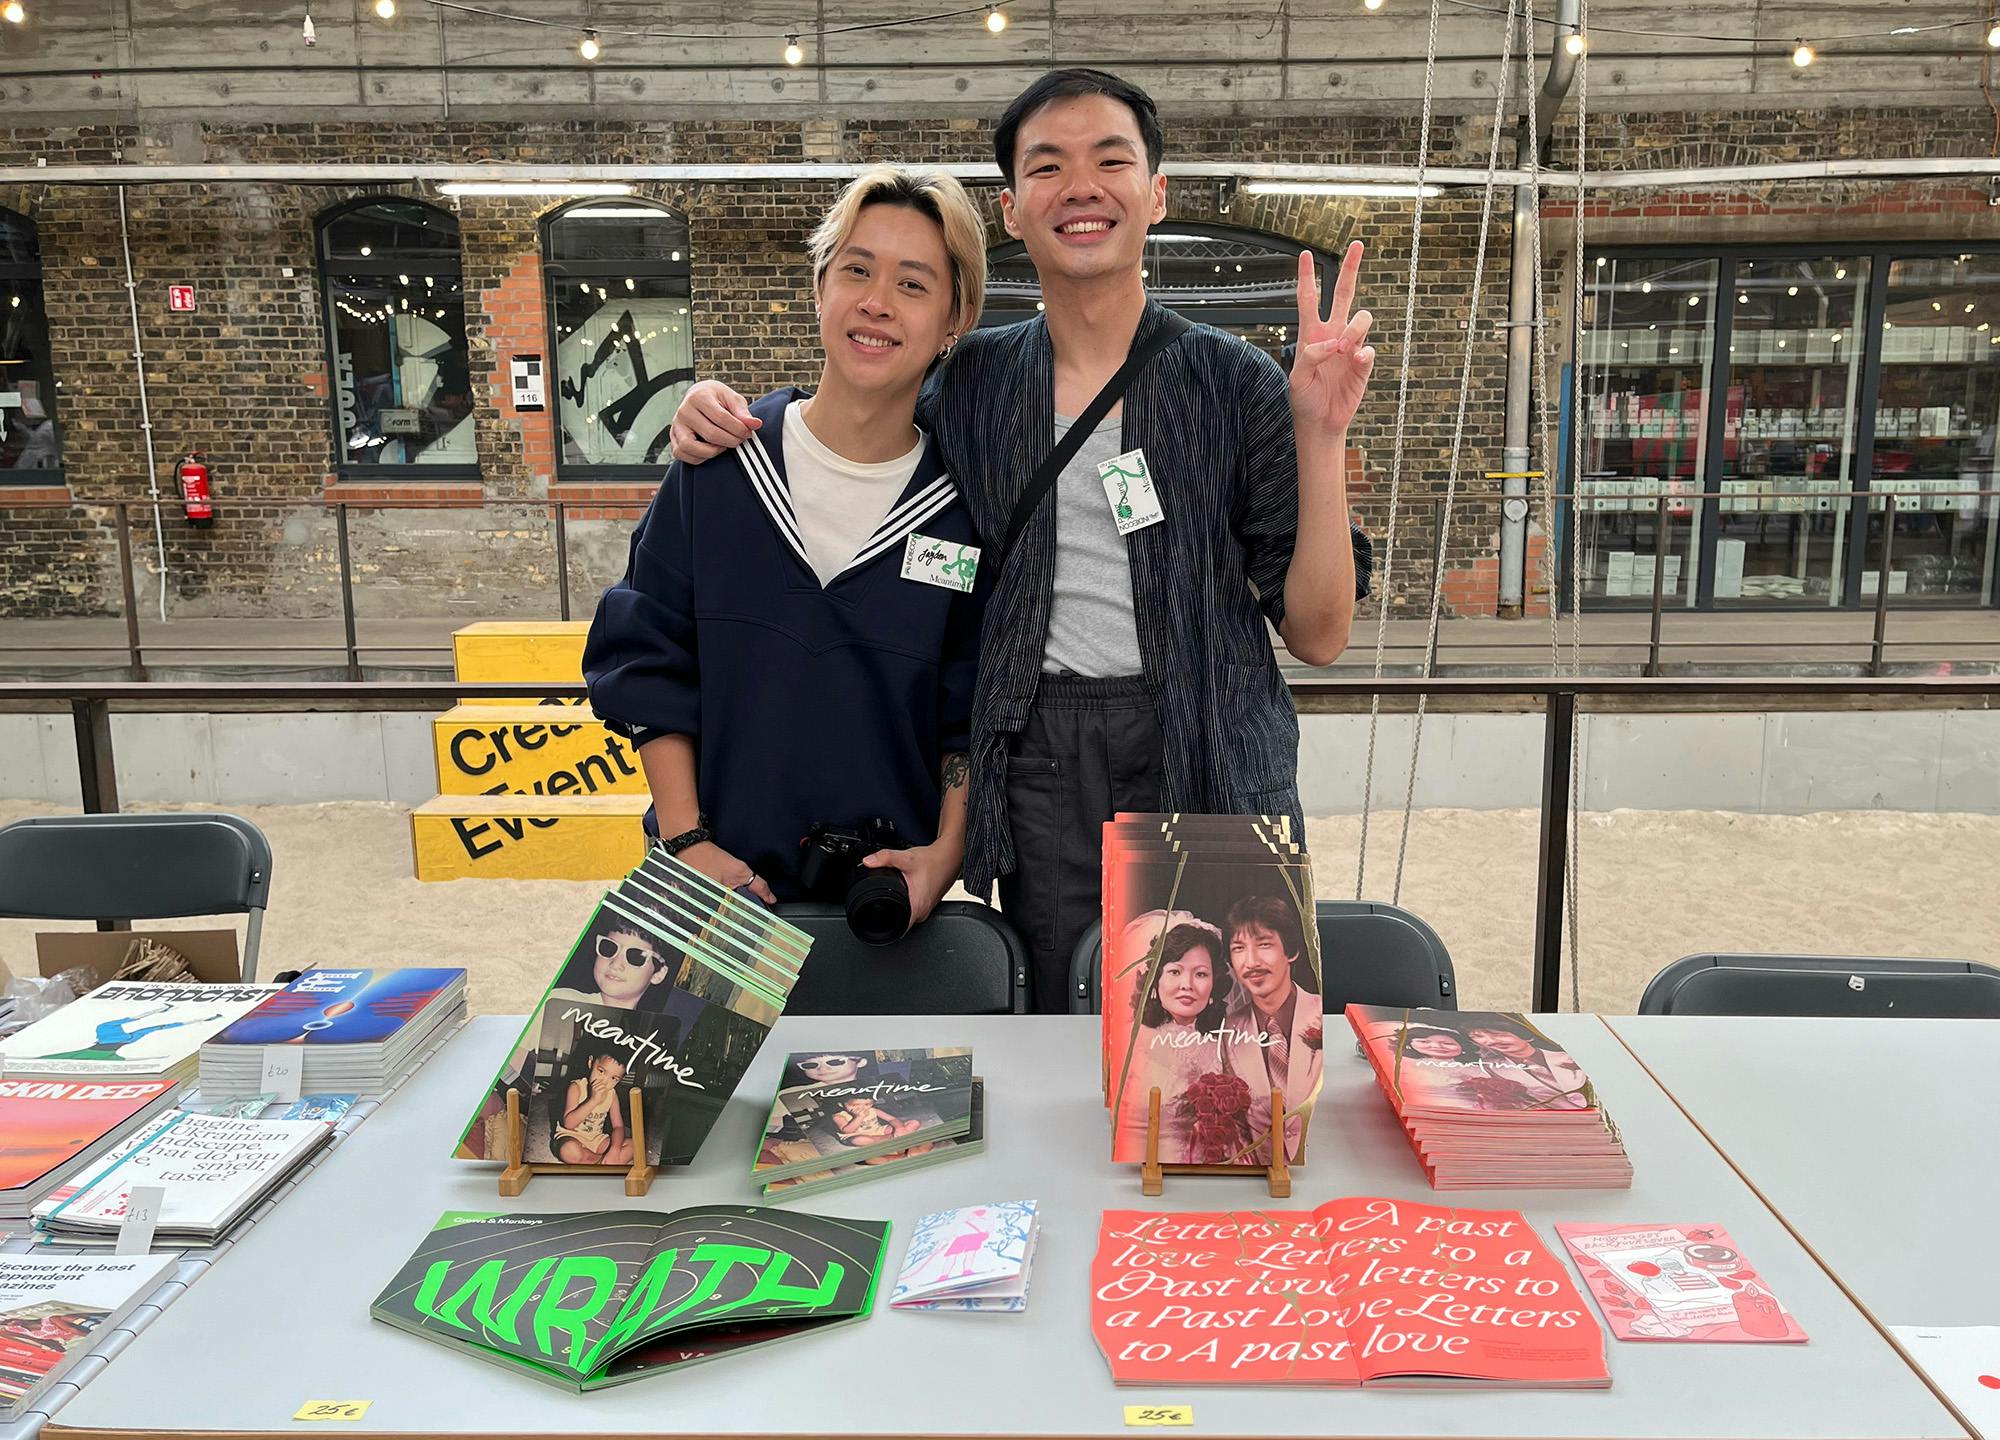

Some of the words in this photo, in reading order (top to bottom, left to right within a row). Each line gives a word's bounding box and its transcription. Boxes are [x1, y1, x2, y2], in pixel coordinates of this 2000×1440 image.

[521, 394, 538, 402] 116
[92, 987, 280, 1002] BROADCAST
[561, 1006, 705, 1090] meantime
[1150, 1018, 1282, 1062] meantime
[1416, 1058, 1545, 1078] meantime
[0, 1082, 77, 1099] SKIN
[68, 1084, 164, 1099] DEEP
[798, 1080, 947, 1100] meantime
[170, 1125, 289, 1141] Ukrainian
[194, 1148, 224, 1160] do
[231, 1151, 280, 1166] you
[159, 1170, 237, 1182] taste?
[497, 1218, 543, 1226] Monkeys
[1109, 1217, 1279, 1245] Letters
[1291, 1217, 1333, 1238] to
[1338, 1201, 1399, 1232] A
[1415, 1216, 1519, 1237] past
[1112, 1244, 1217, 1267] love
[1504, 1250, 1533, 1266] a
[0, 1262, 61, 1271] iscover
[63, 1263, 92, 1271] the
[94, 1264, 136, 1272] best
[0, 1272, 85, 1281] ependent
[1097, 1269, 1242, 1301] Past
[1246, 1270, 1349, 1297] love
[1359, 1258, 1506, 1294] letters
[1514, 1278, 1560, 1296] to
[0, 1282, 56, 1290] azines
[1105, 1310, 1142, 1328] a
[1147, 1306, 1266, 1328] Past
[1269, 1298, 1393, 1328] Love
[1395, 1293, 1582, 1328] Letters
[1118, 1340, 1172, 1362] to
[1176, 1337, 1219, 1361] A
[1230, 1339, 1355, 1369] past
[1362, 1323, 1470, 1358] love
